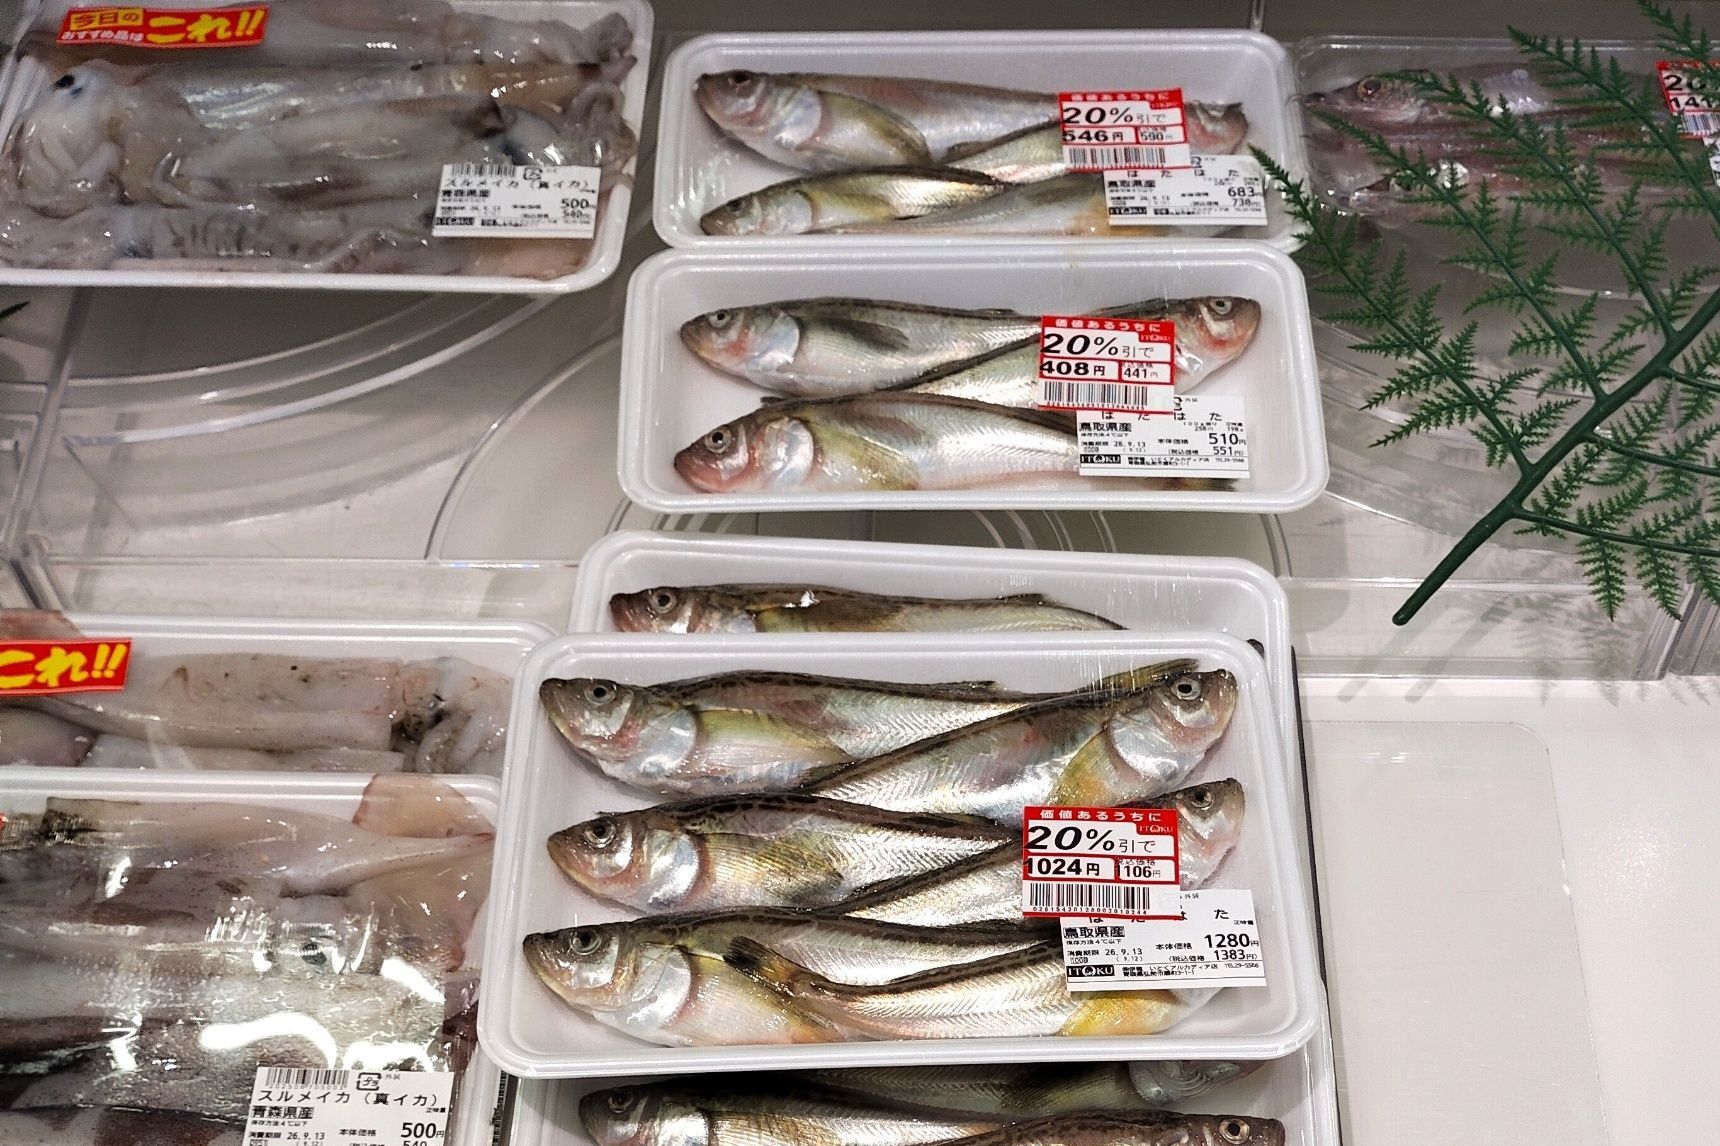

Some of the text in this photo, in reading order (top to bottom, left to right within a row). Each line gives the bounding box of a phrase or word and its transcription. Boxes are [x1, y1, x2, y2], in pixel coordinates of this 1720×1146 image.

[1063, 129, 1124, 142] 546円
[1056, 319, 1161, 333] 価値あるうちに
[1040, 361, 1105, 376] 408円
[1124, 367, 1159, 379] 441円
[1079, 422, 1132, 432] 鳥取県産
[1208, 432, 1246, 446] 510円
[1081, 454, 1120, 464] ITOKU
[1040, 809, 1161, 822] 価値あるうちに
[1139, 824, 1173, 833] ITOKU
[1023, 857, 1100, 877] 1024円
[1064, 926, 1125, 939] 鳥取県産
[1204, 933, 1260, 948] 1280円
[1067, 966, 1114, 976] ITOKU
[259, 1090, 438, 1106] スルメイカ（真イカ）
[252, 1105, 314, 1119] 青森県産
[400, 1121, 444, 1139] 500円
